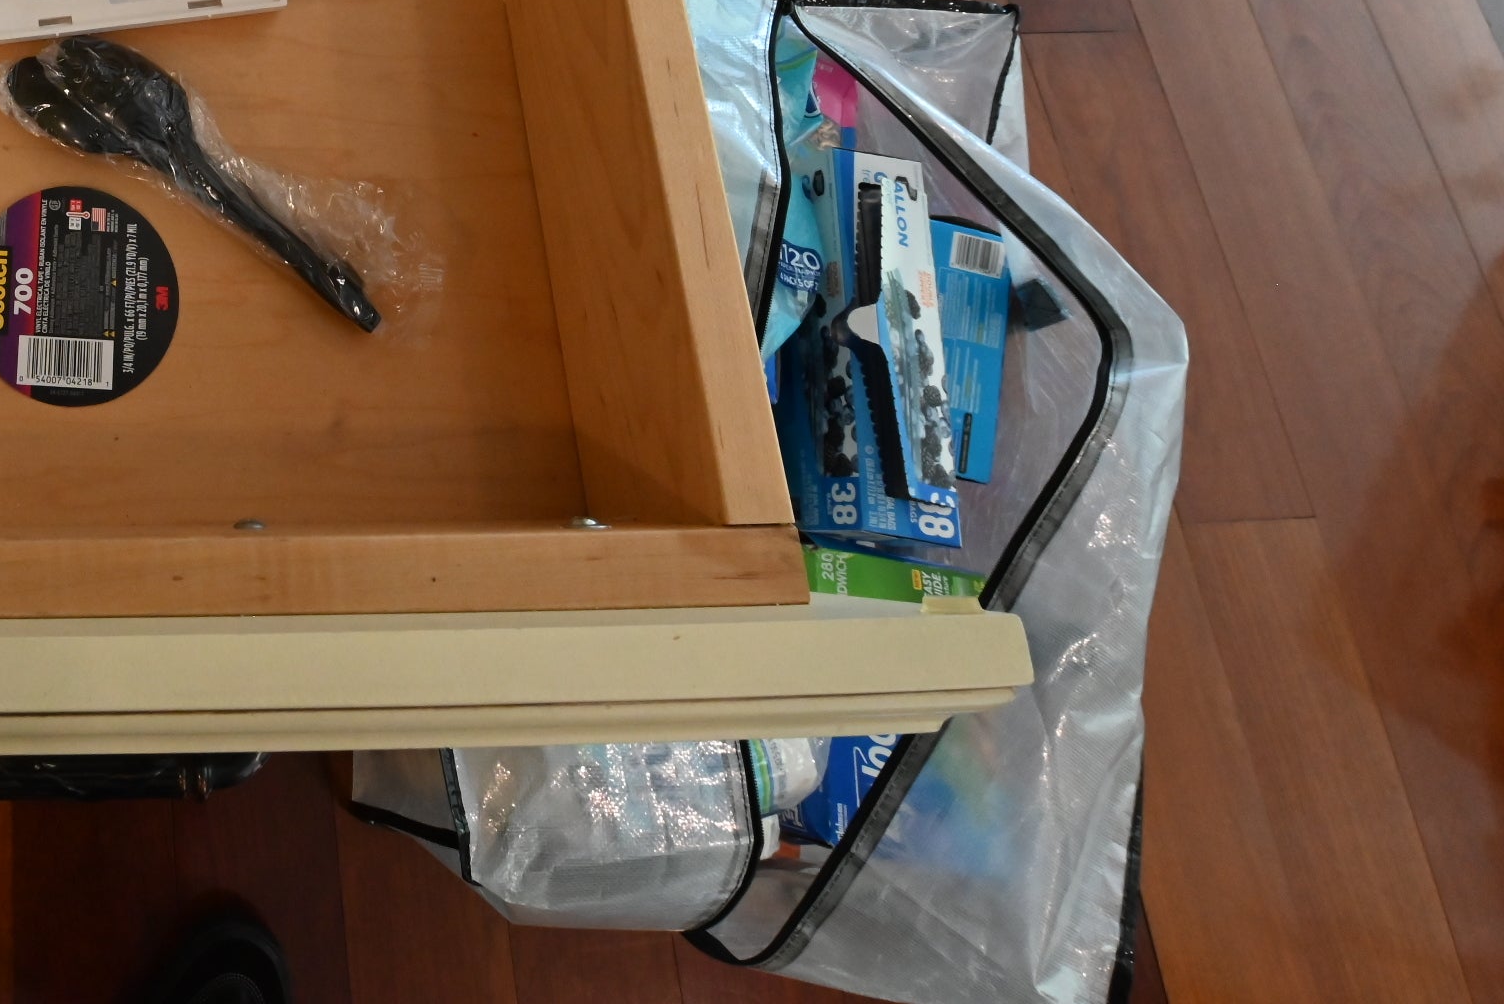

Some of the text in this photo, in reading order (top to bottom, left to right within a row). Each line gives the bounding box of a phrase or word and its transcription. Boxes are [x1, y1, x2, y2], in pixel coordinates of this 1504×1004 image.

[41, 217, 47, 225] EN
[127, 223, 137, 233] MIL
[45, 279, 50, 287] DE
[14, 267, 34, 315] 700
[155, 286, 169, 311] 3M
[137, 300, 148, 312] 20,1
[136, 331, 148, 340] (19
[122, 362, 134, 374] 3/4
[36, 375, 61, 384] 54007
[66, 376, 93, 386] 04218
[831, 482, 857, 525] 38
[821, 553, 835, 581] 280
